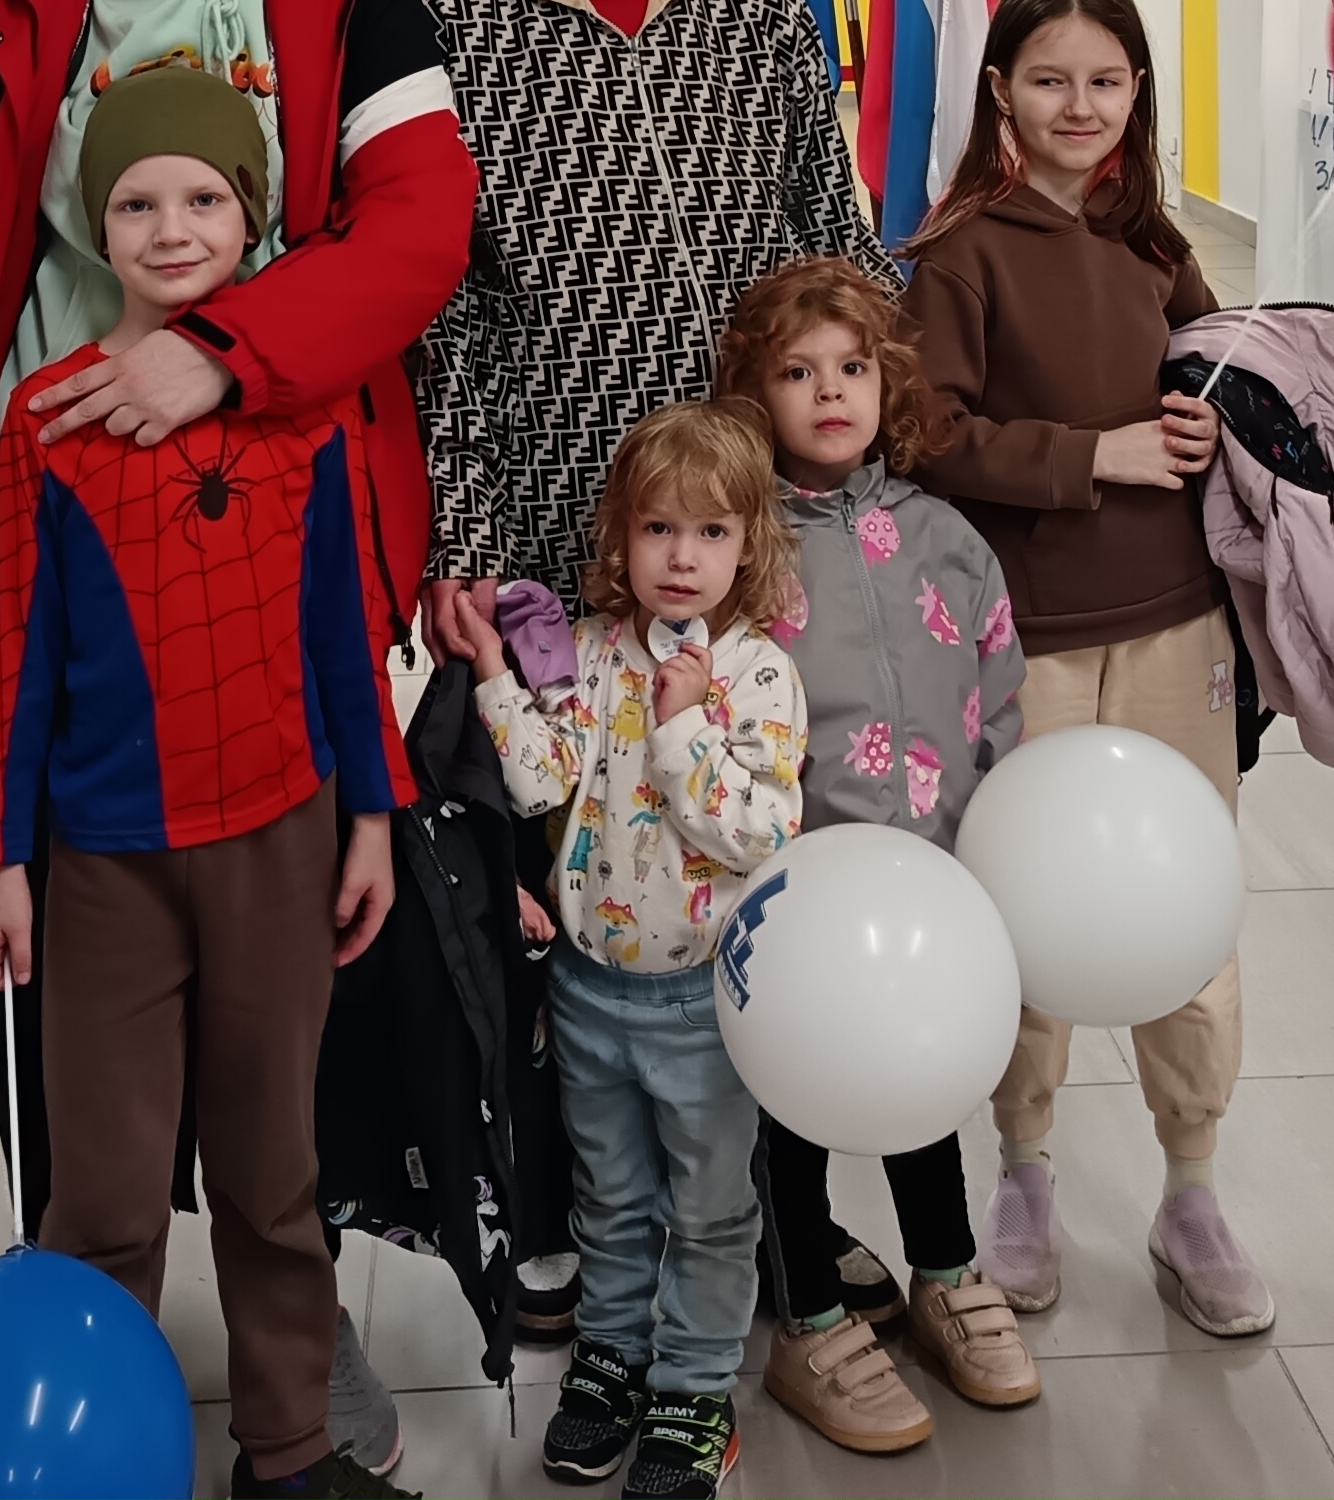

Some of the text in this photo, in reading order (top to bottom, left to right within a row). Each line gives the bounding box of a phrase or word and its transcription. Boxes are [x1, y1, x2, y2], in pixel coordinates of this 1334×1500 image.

[571, 1377, 605, 1395] SPORT
[647, 1406, 698, 1418] ALEMY
[653, 1426, 694, 1443] SPORT
